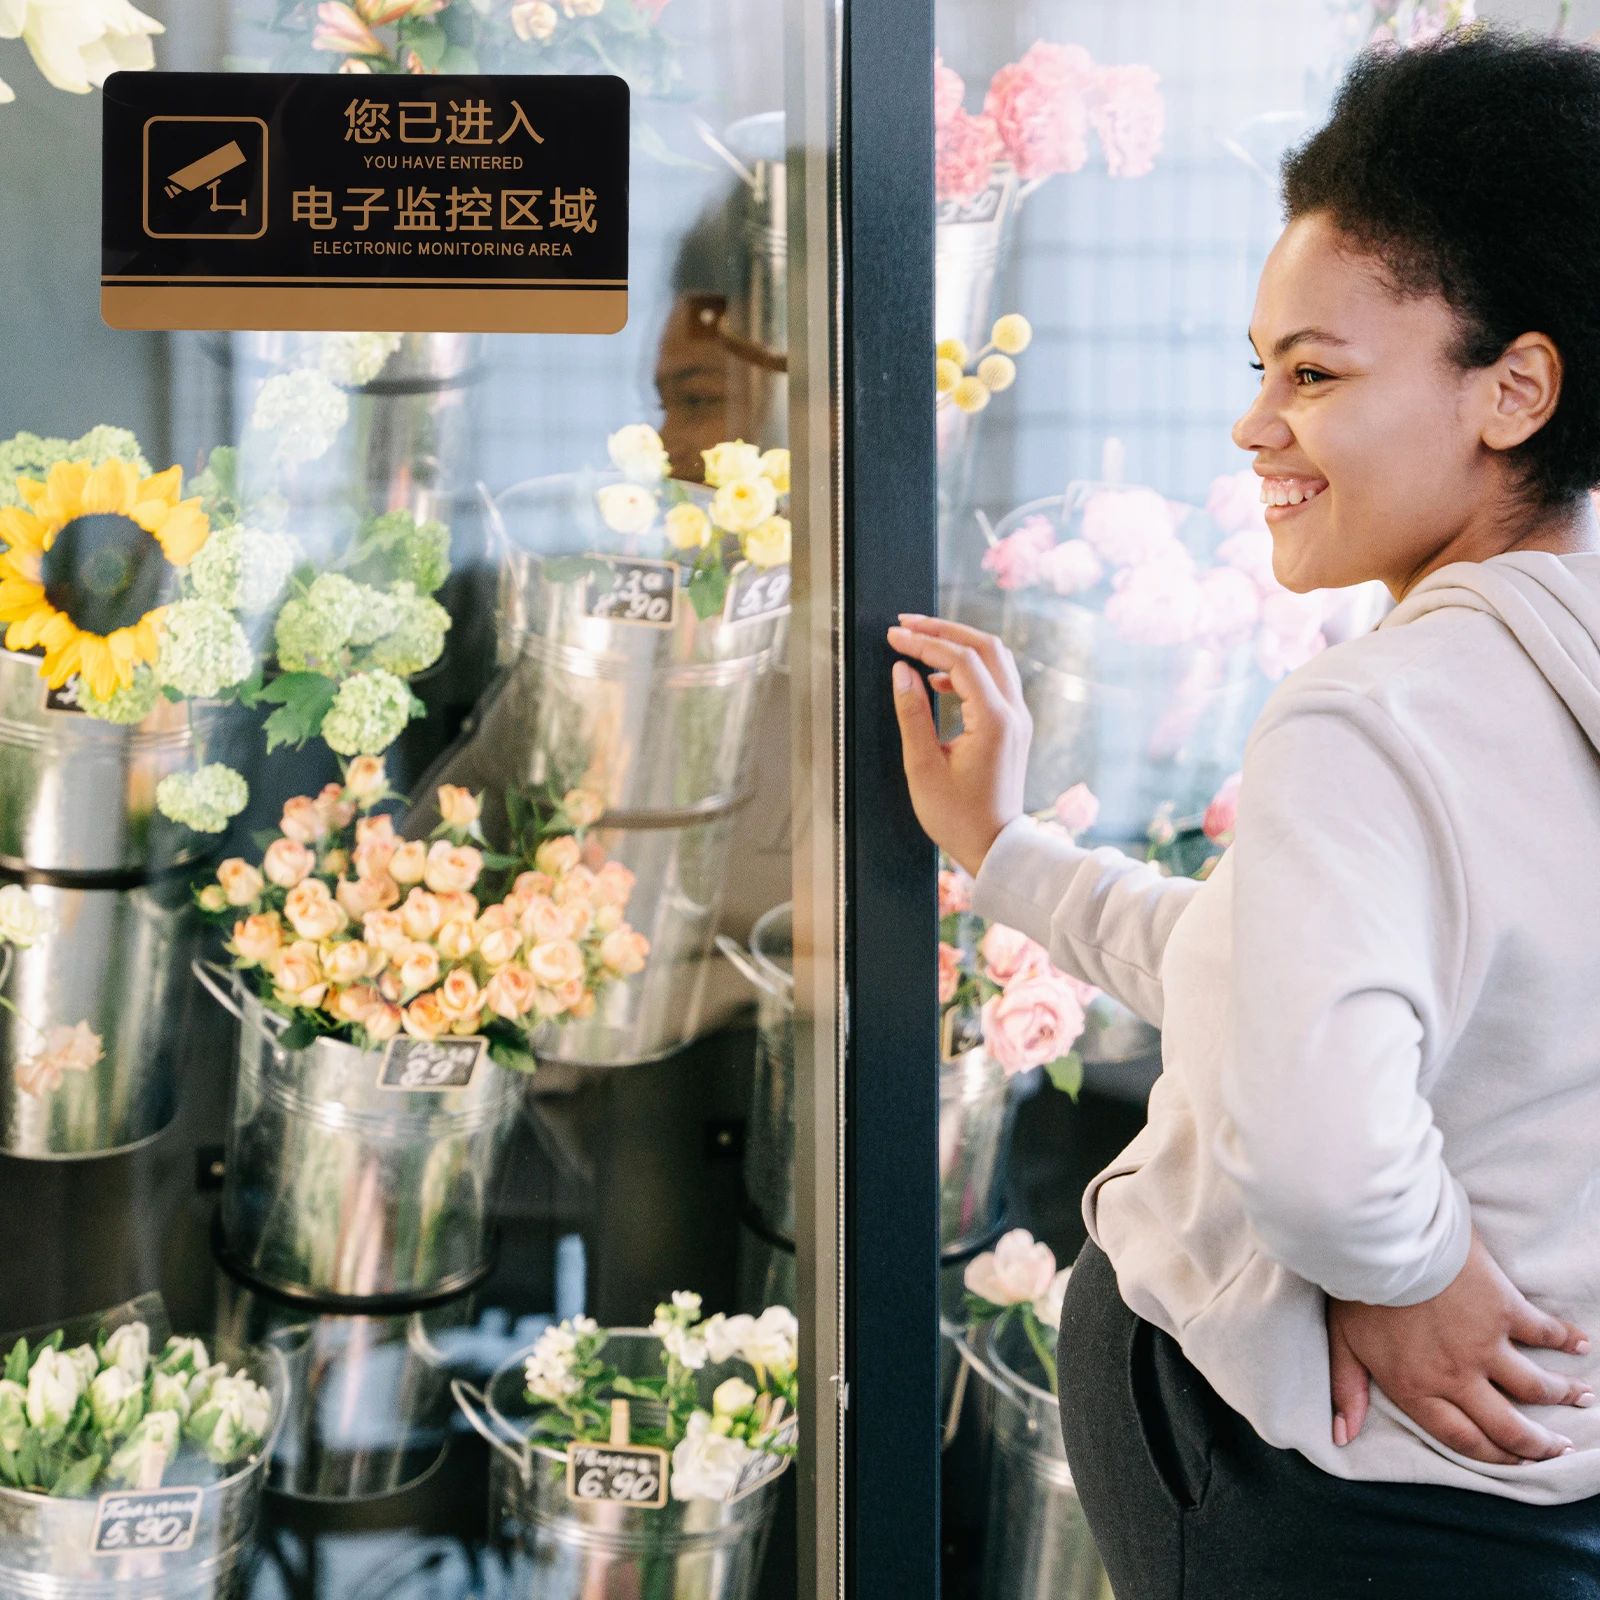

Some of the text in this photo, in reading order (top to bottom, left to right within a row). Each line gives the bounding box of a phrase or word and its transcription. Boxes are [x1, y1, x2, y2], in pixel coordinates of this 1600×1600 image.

[343, 98, 545, 145] 您已进入
[363, 155, 524, 170] YOU HAVE ENTERED
[292, 185, 598, 234] 电子监控区域
[313, 241, 573, 257] ELECTRONIC MONITORING AREA
[578, 1467, 659, 1501] 6.90
